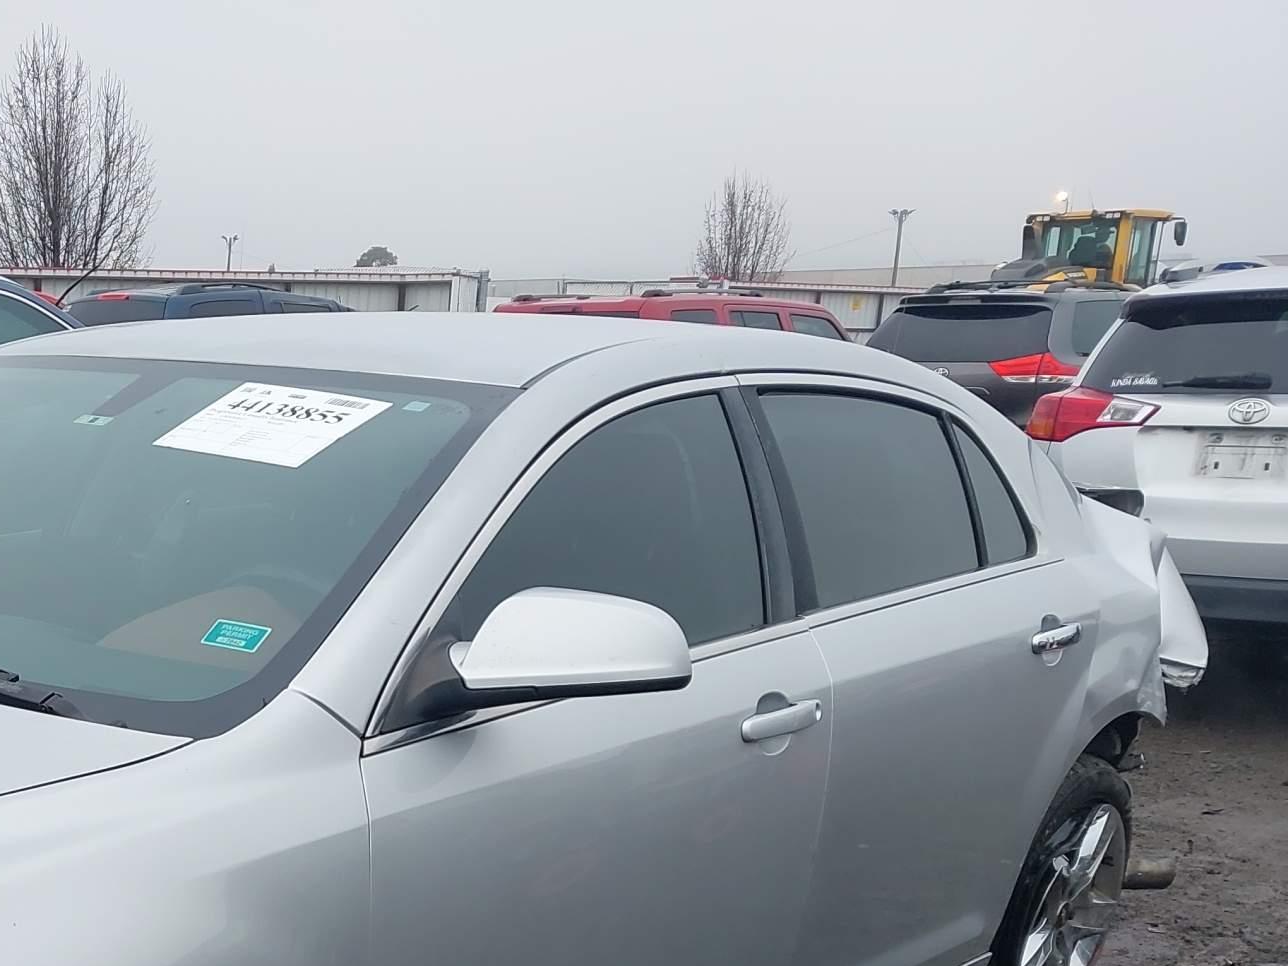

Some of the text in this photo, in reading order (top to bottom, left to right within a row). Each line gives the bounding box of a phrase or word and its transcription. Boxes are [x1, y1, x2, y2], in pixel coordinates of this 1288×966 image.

[228, 398, 352, 424] 44138855
[219, 630, 254, 641] PERMIT
[221, 624, 260, 637] PARKING
